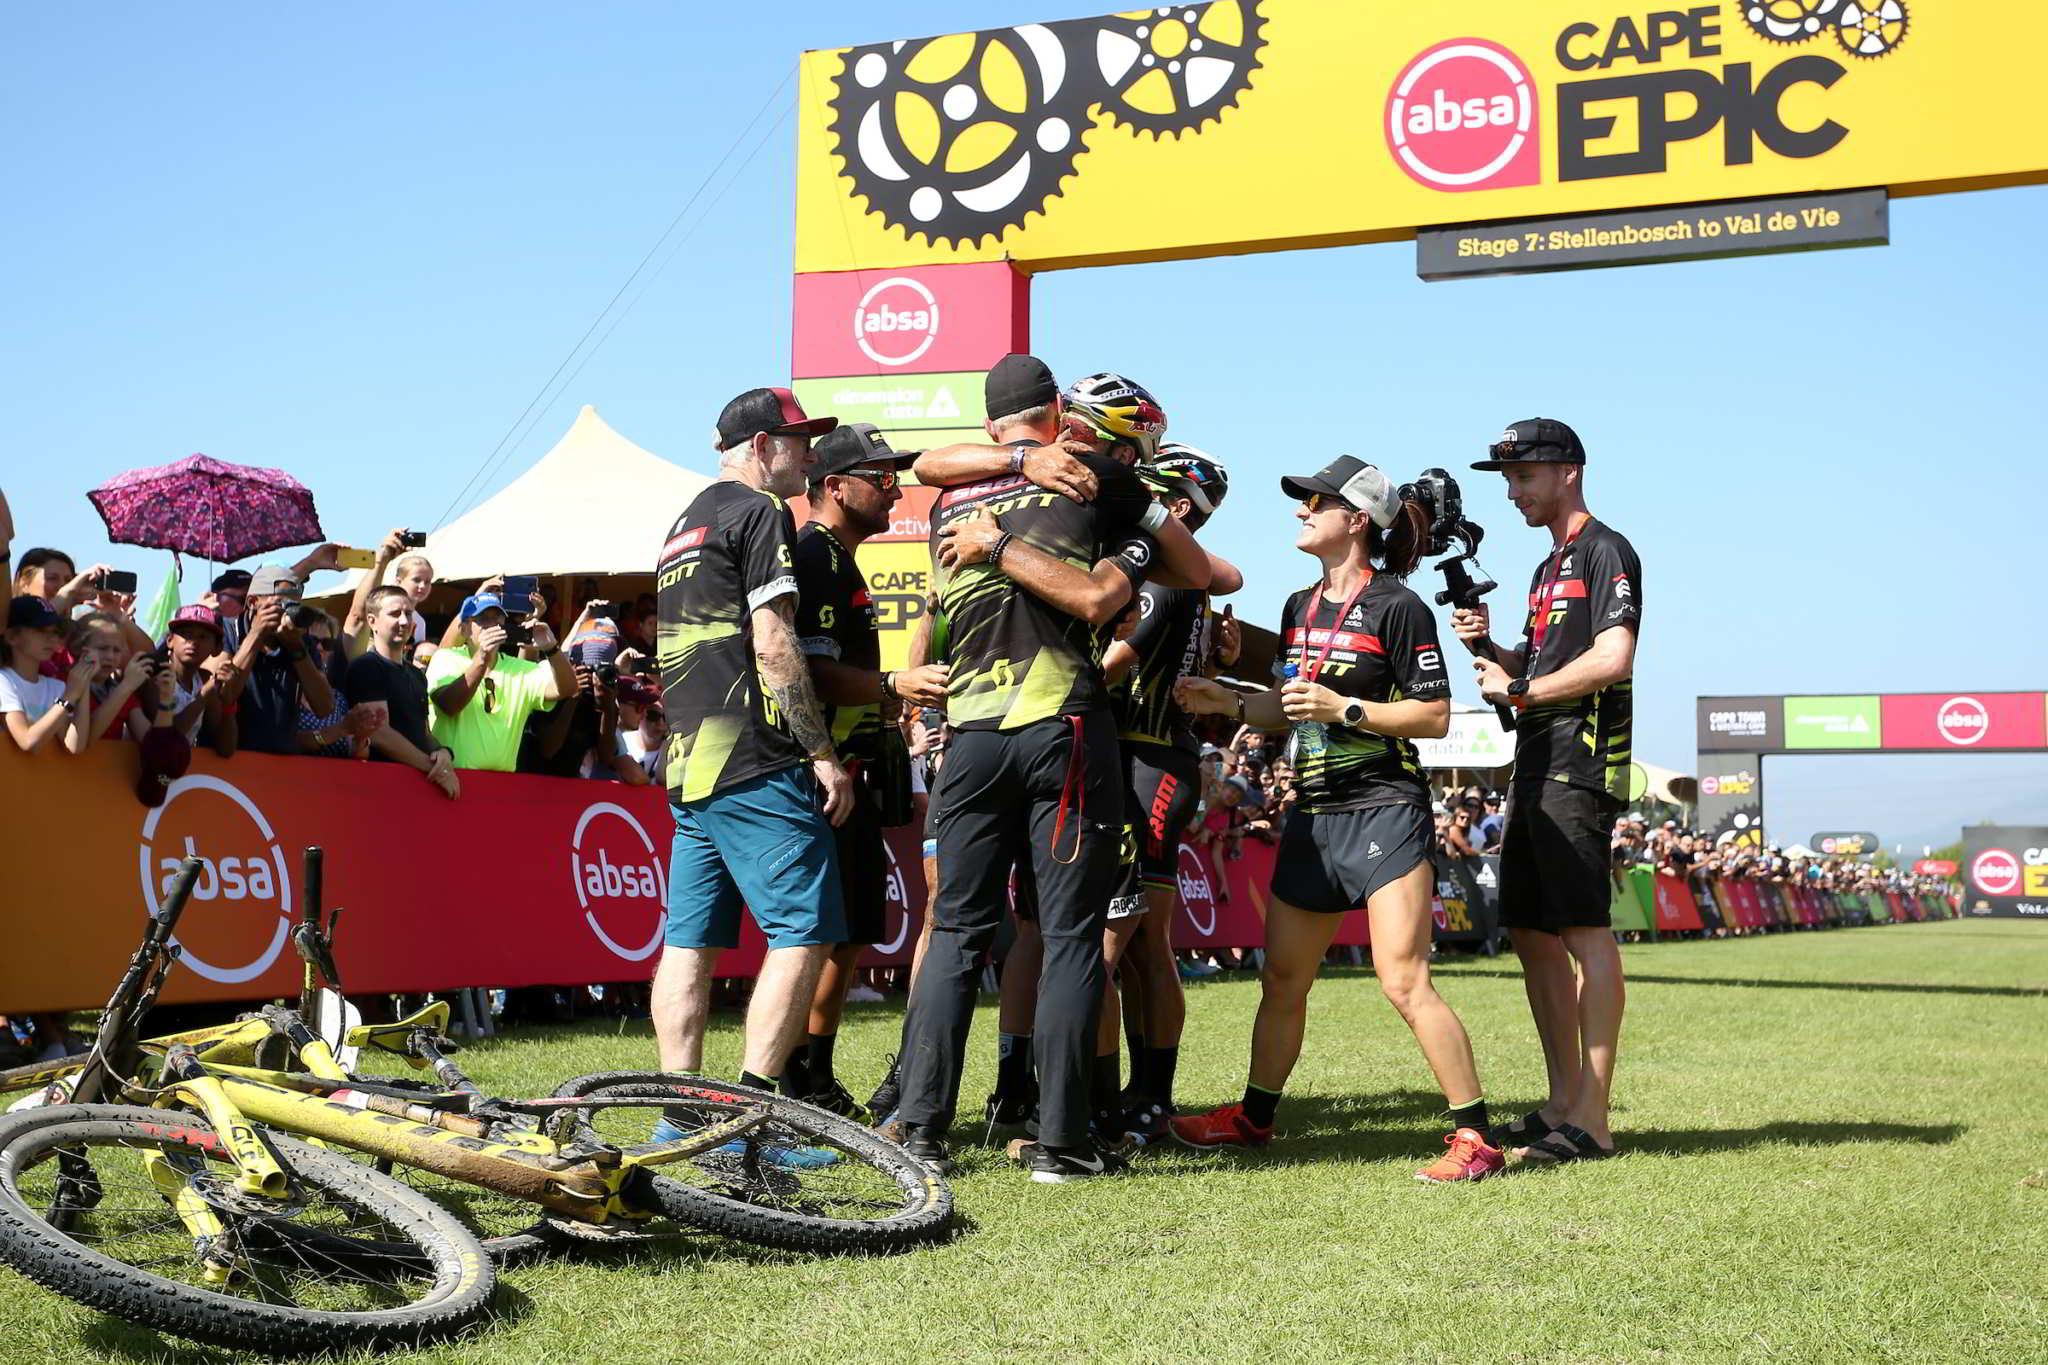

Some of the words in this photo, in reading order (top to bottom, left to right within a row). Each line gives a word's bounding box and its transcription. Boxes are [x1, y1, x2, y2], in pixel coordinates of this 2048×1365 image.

[1556, 6, 1721, 71] CAPE
[1408, 88, 1514, 136] absa
[1557, 55, 1850, 182] EPIC
[1458, 233, 1519, 258] Stage
[1526, 233, 1545, 251] 7:
[1548, 220, 1693, 250] Stellenbosch
[1699, 219, 1721, 236] to
[1725, 215, 1762, 235] Val
[1768, 212, 1796, 232] de
[1802, 208, 1840, 228] Vie
[864, 304, 929, 332] absa
[949, 473, 1025, 501] SRA
[870, 572, 927, 590] CAPE
[872, 594, 929, 630] EP
[1411, 679, 1448, 693] syncro
[1943, 710, 1982, 727] absa
[1151, 773, 1177, 841] RAM
[160, 836, 275, 901] absa
[585, 848, 657, 898] absa
[1182, 871, 1210, 899] absa
[1979, 862, 2014, 878] absa
